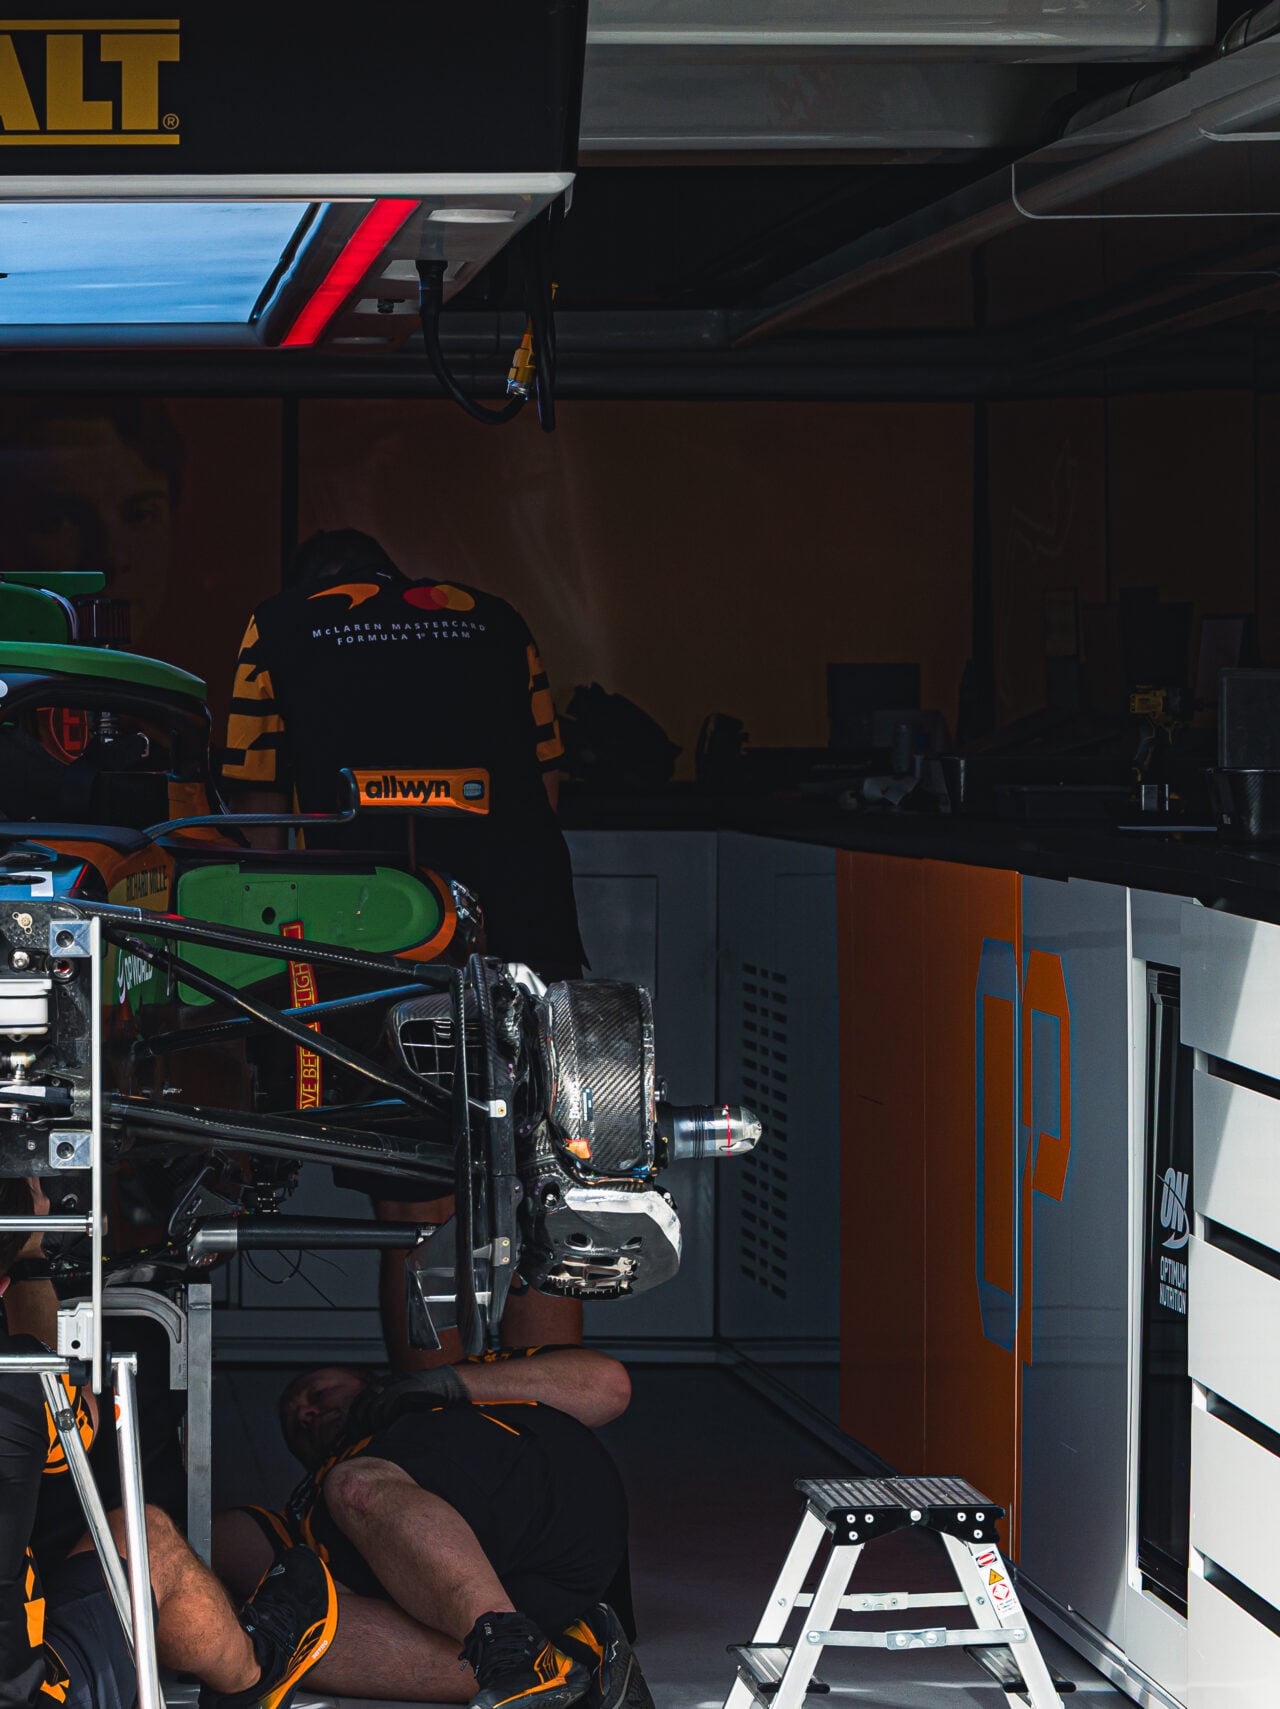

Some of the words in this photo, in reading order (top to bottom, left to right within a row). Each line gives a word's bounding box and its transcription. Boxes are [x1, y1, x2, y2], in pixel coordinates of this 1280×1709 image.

[312, 622, 382, 639] McLAREN
[391, 620, 486, 632] MASTERCARD
[337, 633, 408, 646] FORMULA
[433, 631, 470, 640] TEAM
[366, 775, 450, 803] allwyn
